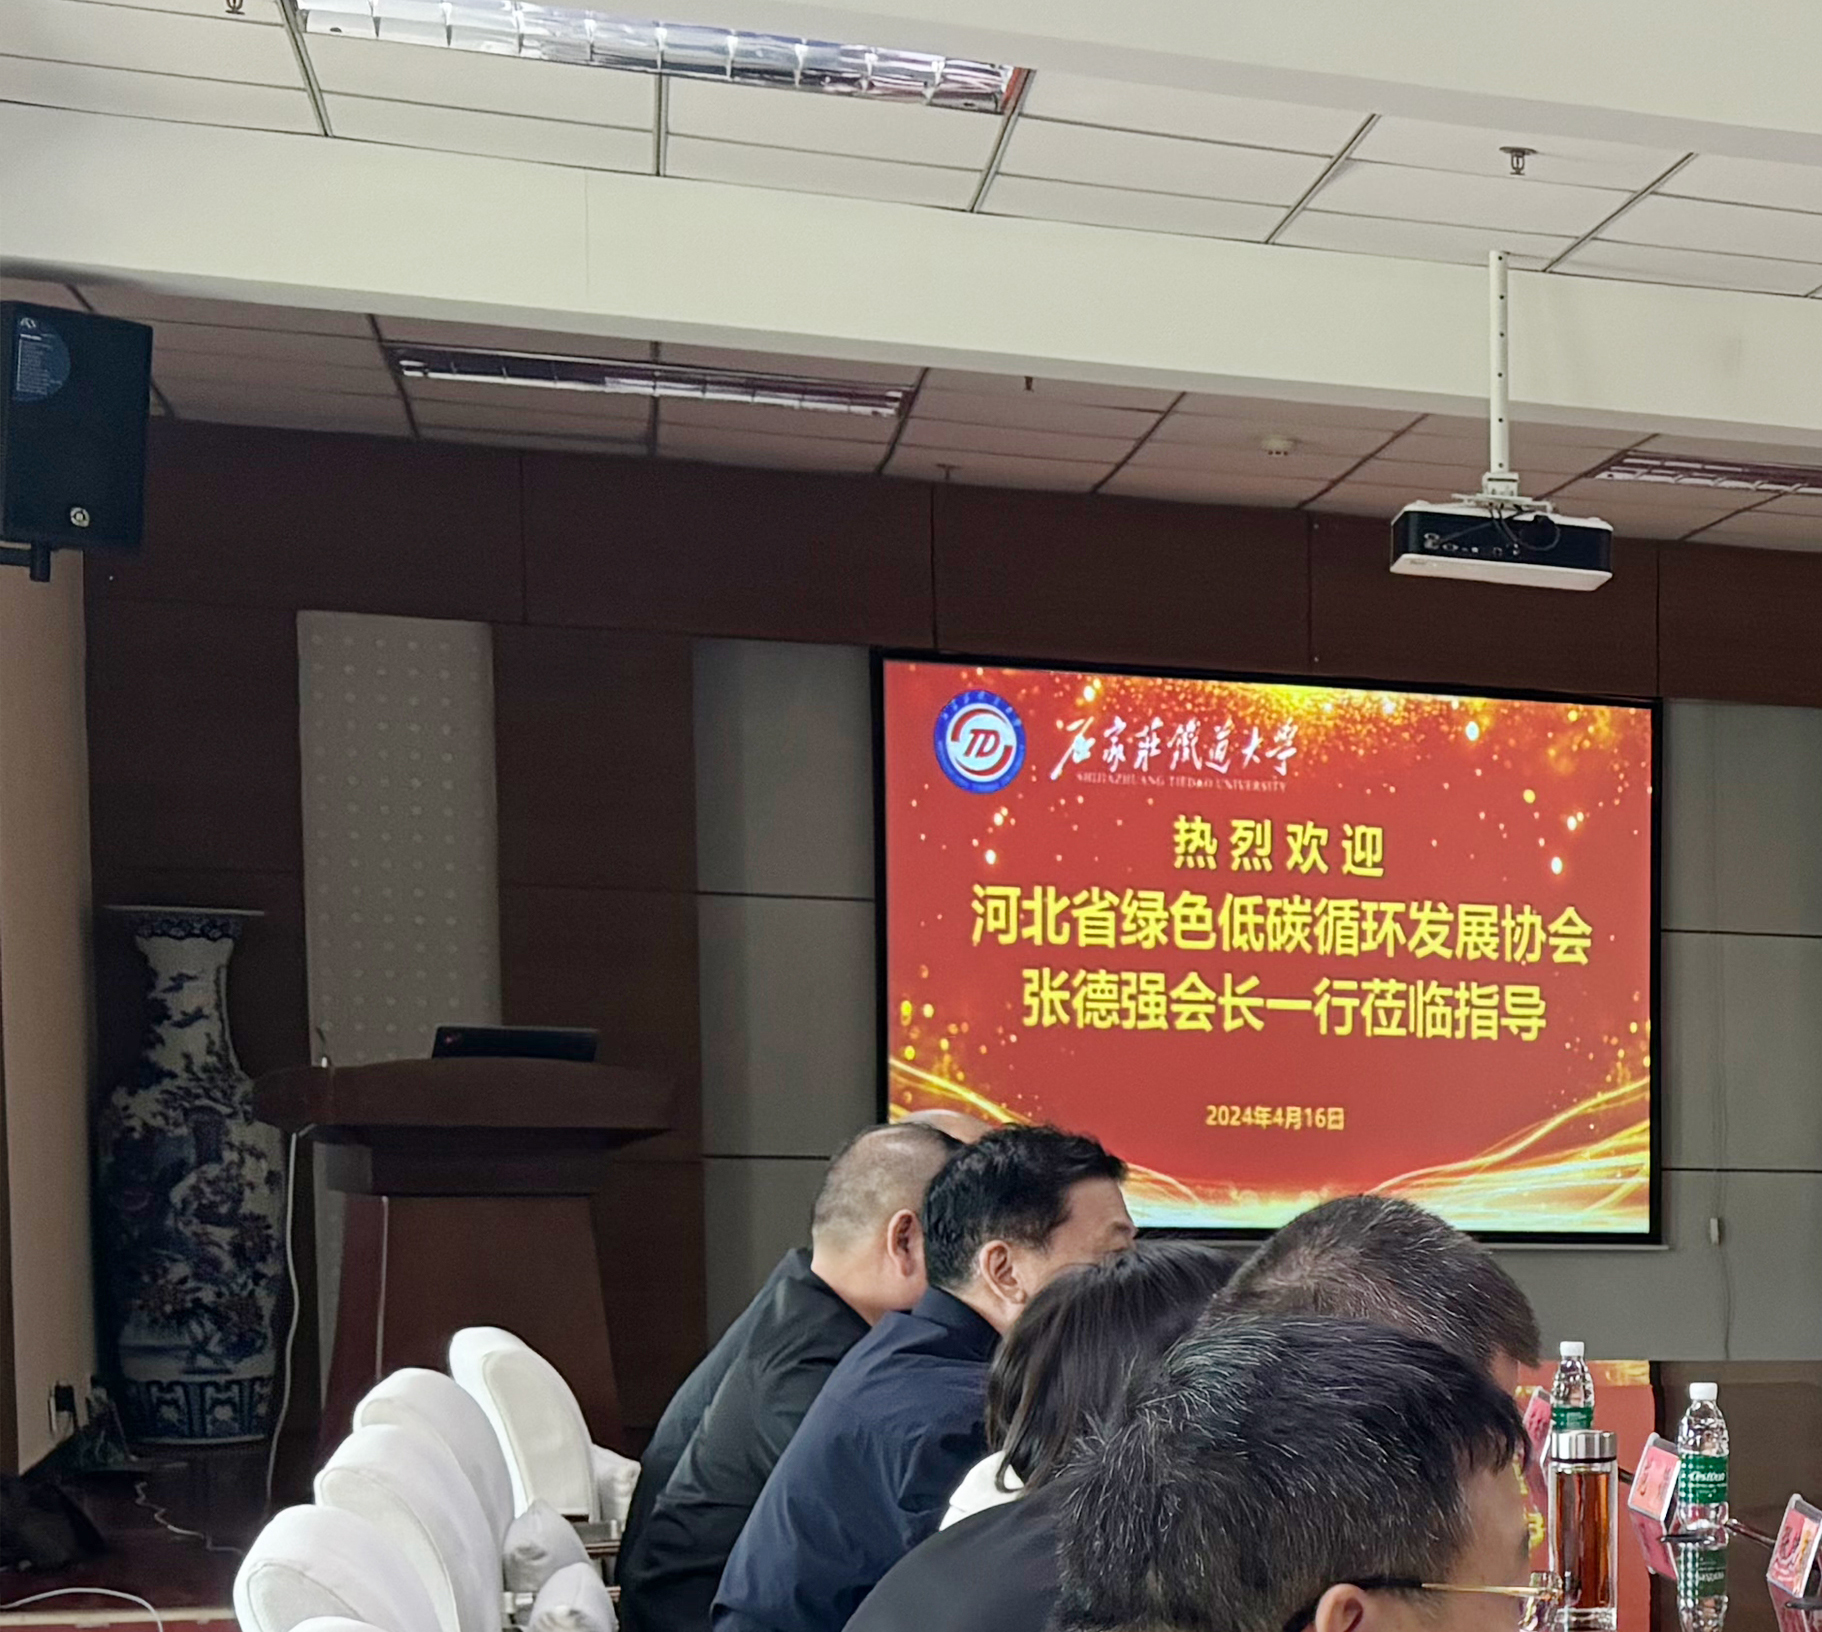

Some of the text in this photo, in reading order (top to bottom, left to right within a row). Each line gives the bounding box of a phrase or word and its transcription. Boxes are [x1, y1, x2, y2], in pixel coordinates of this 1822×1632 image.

[1172, 815, 1386, 878] 热烈欢迎
[971, 883, 1593, 966] 河北省绿色低碳循环发展协会
[1022, 967, 1548, 1042] 张德强会长一行莅临指导
[1205, 1104, 1345, 1132] 2024年4月16日
